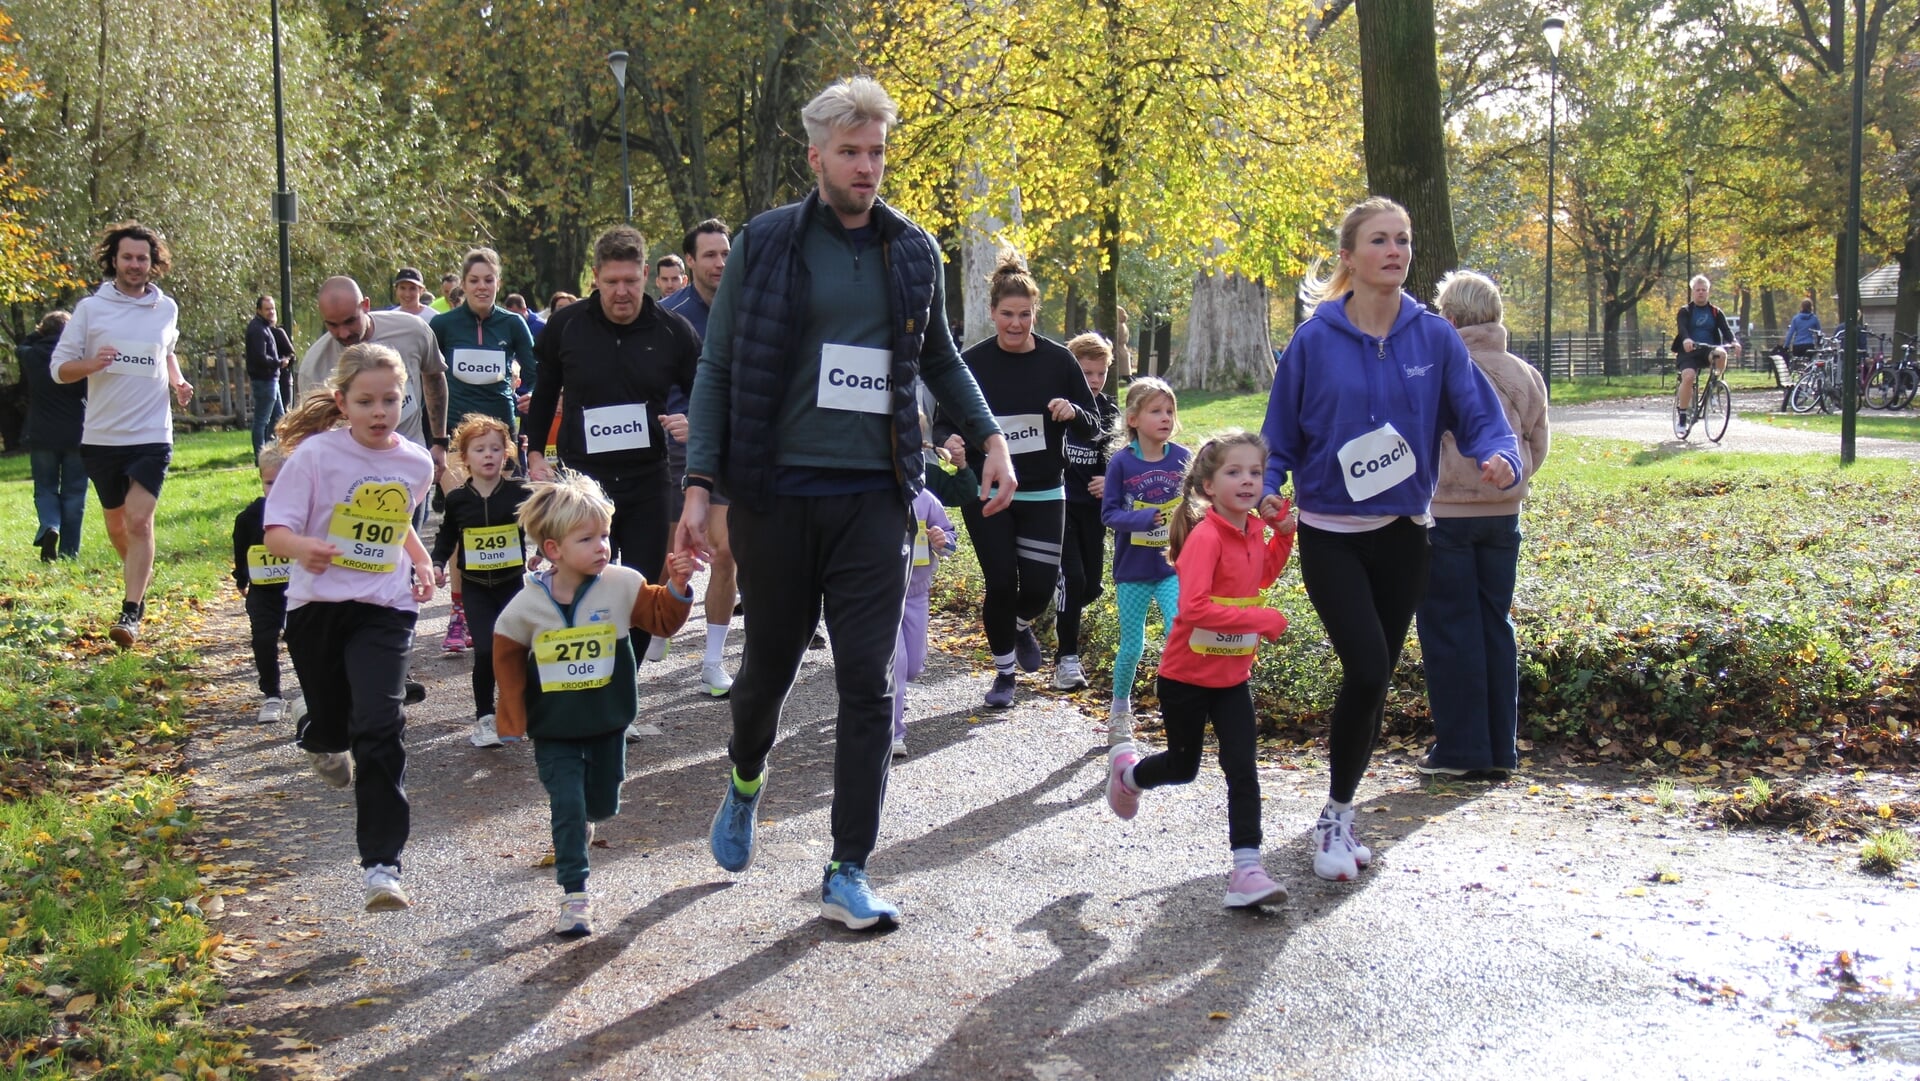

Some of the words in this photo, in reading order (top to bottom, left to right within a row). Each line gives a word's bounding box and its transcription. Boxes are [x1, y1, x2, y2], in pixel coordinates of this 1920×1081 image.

[114, 352, 155, 366] Coach
[458, 361, 501, 373] Coach
[828, 368, 894, 392] Coach
[590, 420, 643, 437] Coach
[1004, 426, 1038, 441] oach
[1070, 456, 1098, 465] HOVEN
[1350, 440, 1409, 479] Coach
[352, 521, 394, 544] 190
[474, 535, 507, 551] 249
[353, 543, 385, 558] Sara
[479, 551, 505, 561] Dane
[264, 566, 291, 578] JAX
[342, 559, 385, 572] KROONTJE
[1216, 631, 1243, 643] Sam
[555, 639, 601, 662] 279
[1205, 646, 1244, 655] KROONTJE
[567, 662, 595, 676] Ode
[561, 679, 604, 689] KROONTJE
